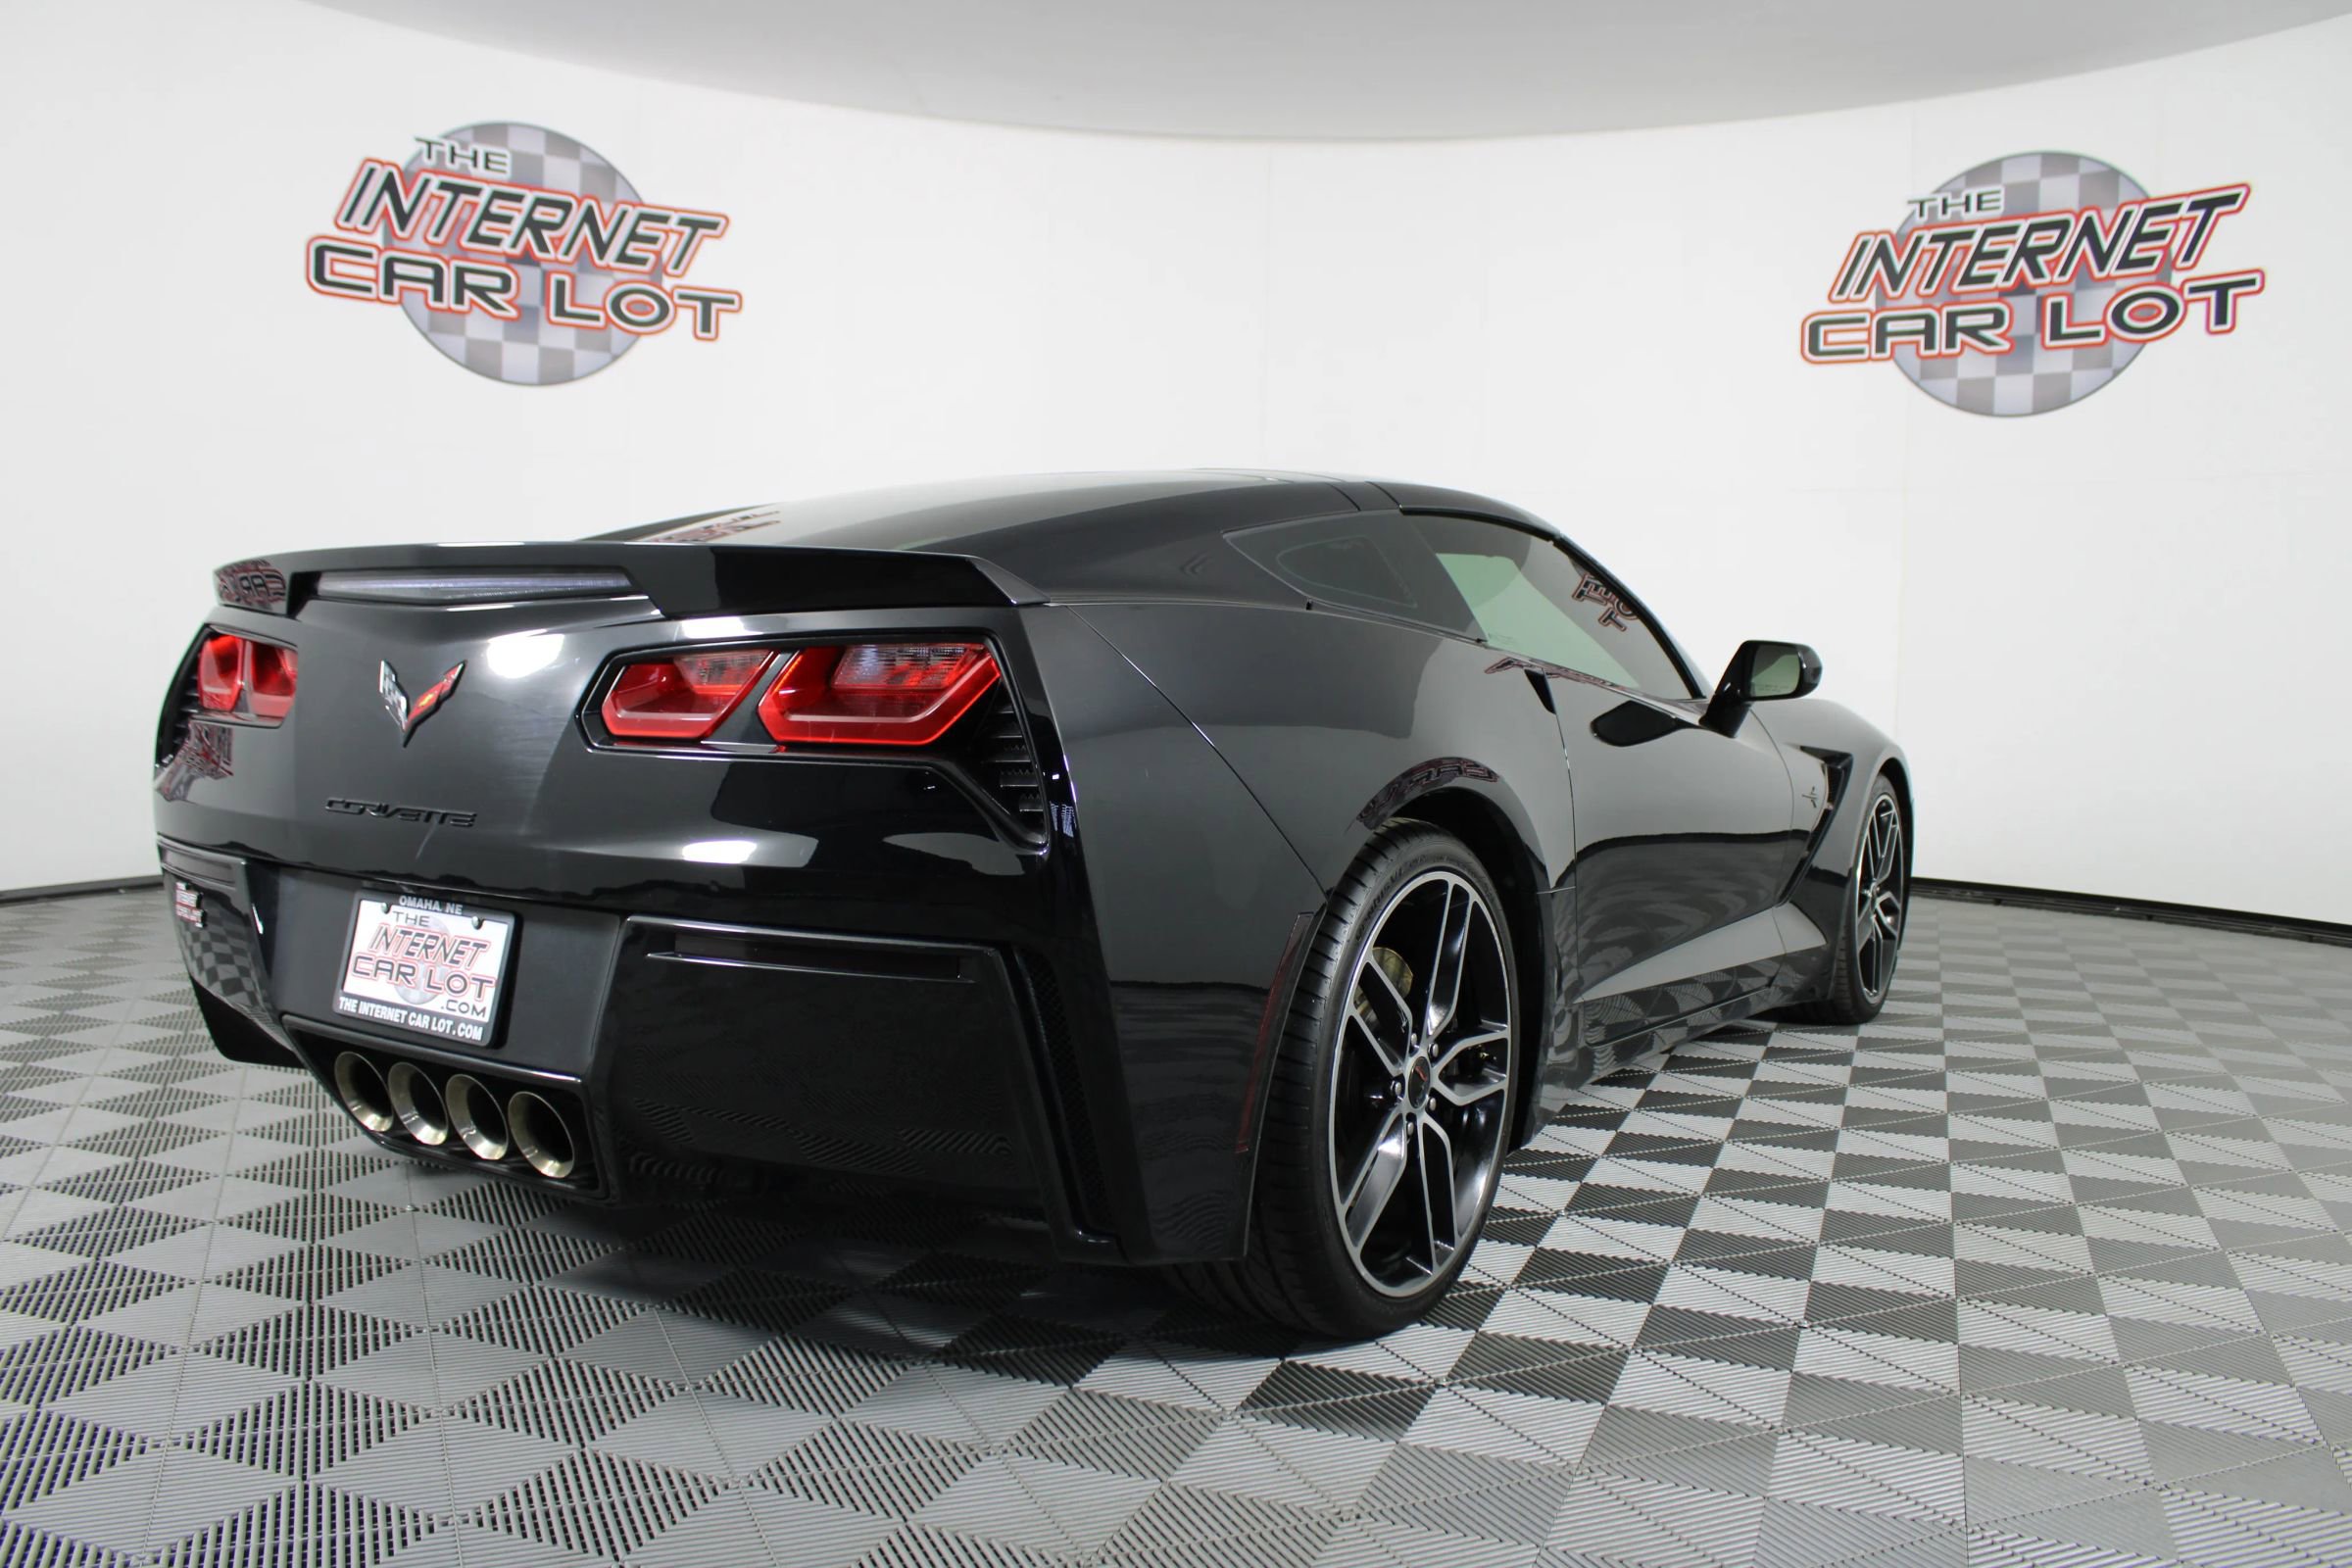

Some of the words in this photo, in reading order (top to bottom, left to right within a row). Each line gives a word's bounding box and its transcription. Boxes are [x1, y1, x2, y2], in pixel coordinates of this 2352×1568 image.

[414, 136, 509, 174] THE
[336, 159, 728, 276] INTERNET
[1906, 189, 2004, 220] THE
[1830, 184, 2250, 303] INTERNET
[308, 236, 519, 319] CAR
[547, 272, 742, 340] LOT
[1803, 300, 2014, 363] CAR
[2042, 270, 2264, 348] LOT
[324, 797, 478, 828] CORVETTE
[392, 910, 430, 927] THE
[445, 902, 464, 916] NE
[368, 924, 489, 969] INTERNET
[352, 955, 416, 987] CAR
[424, 966, 495, 1001] LOT
[338, 996, 359, 1013] THE
[359, 1001, 408, 1025] INTERNET
[408, 1011, 430, 1030] CAR
[441, 999, 487, 1018] .COM
